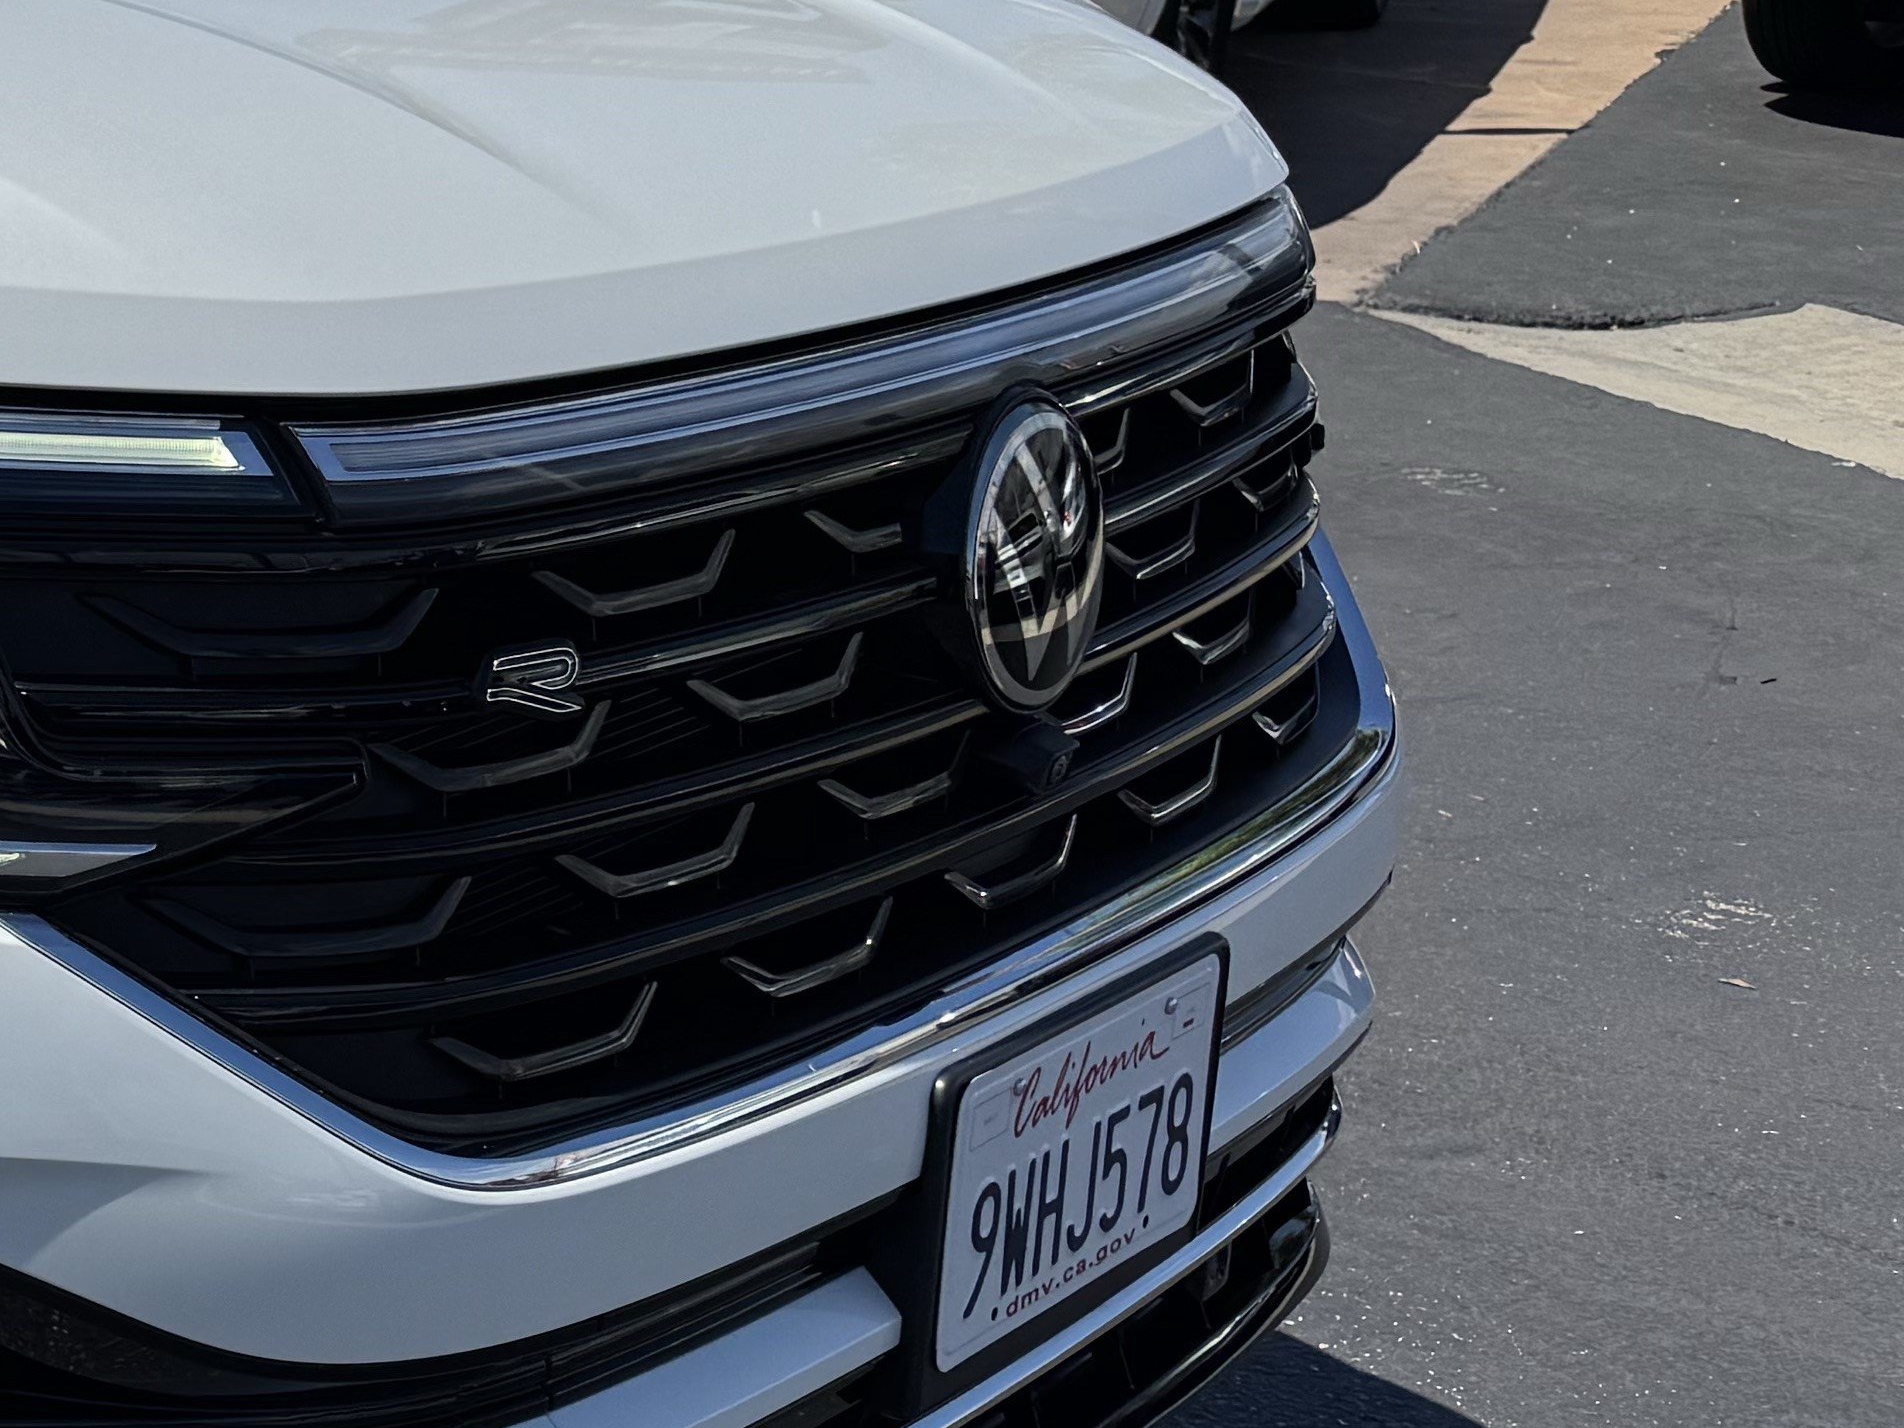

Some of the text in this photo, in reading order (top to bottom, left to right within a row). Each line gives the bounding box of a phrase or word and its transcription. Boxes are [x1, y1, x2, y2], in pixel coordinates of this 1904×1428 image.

[1013, 1018, 1170, 1139] California
[962, 1072, 1194, 1321] 9WHJ578
[1005, 1228, 1136, 1319] dmv.ca.gov
